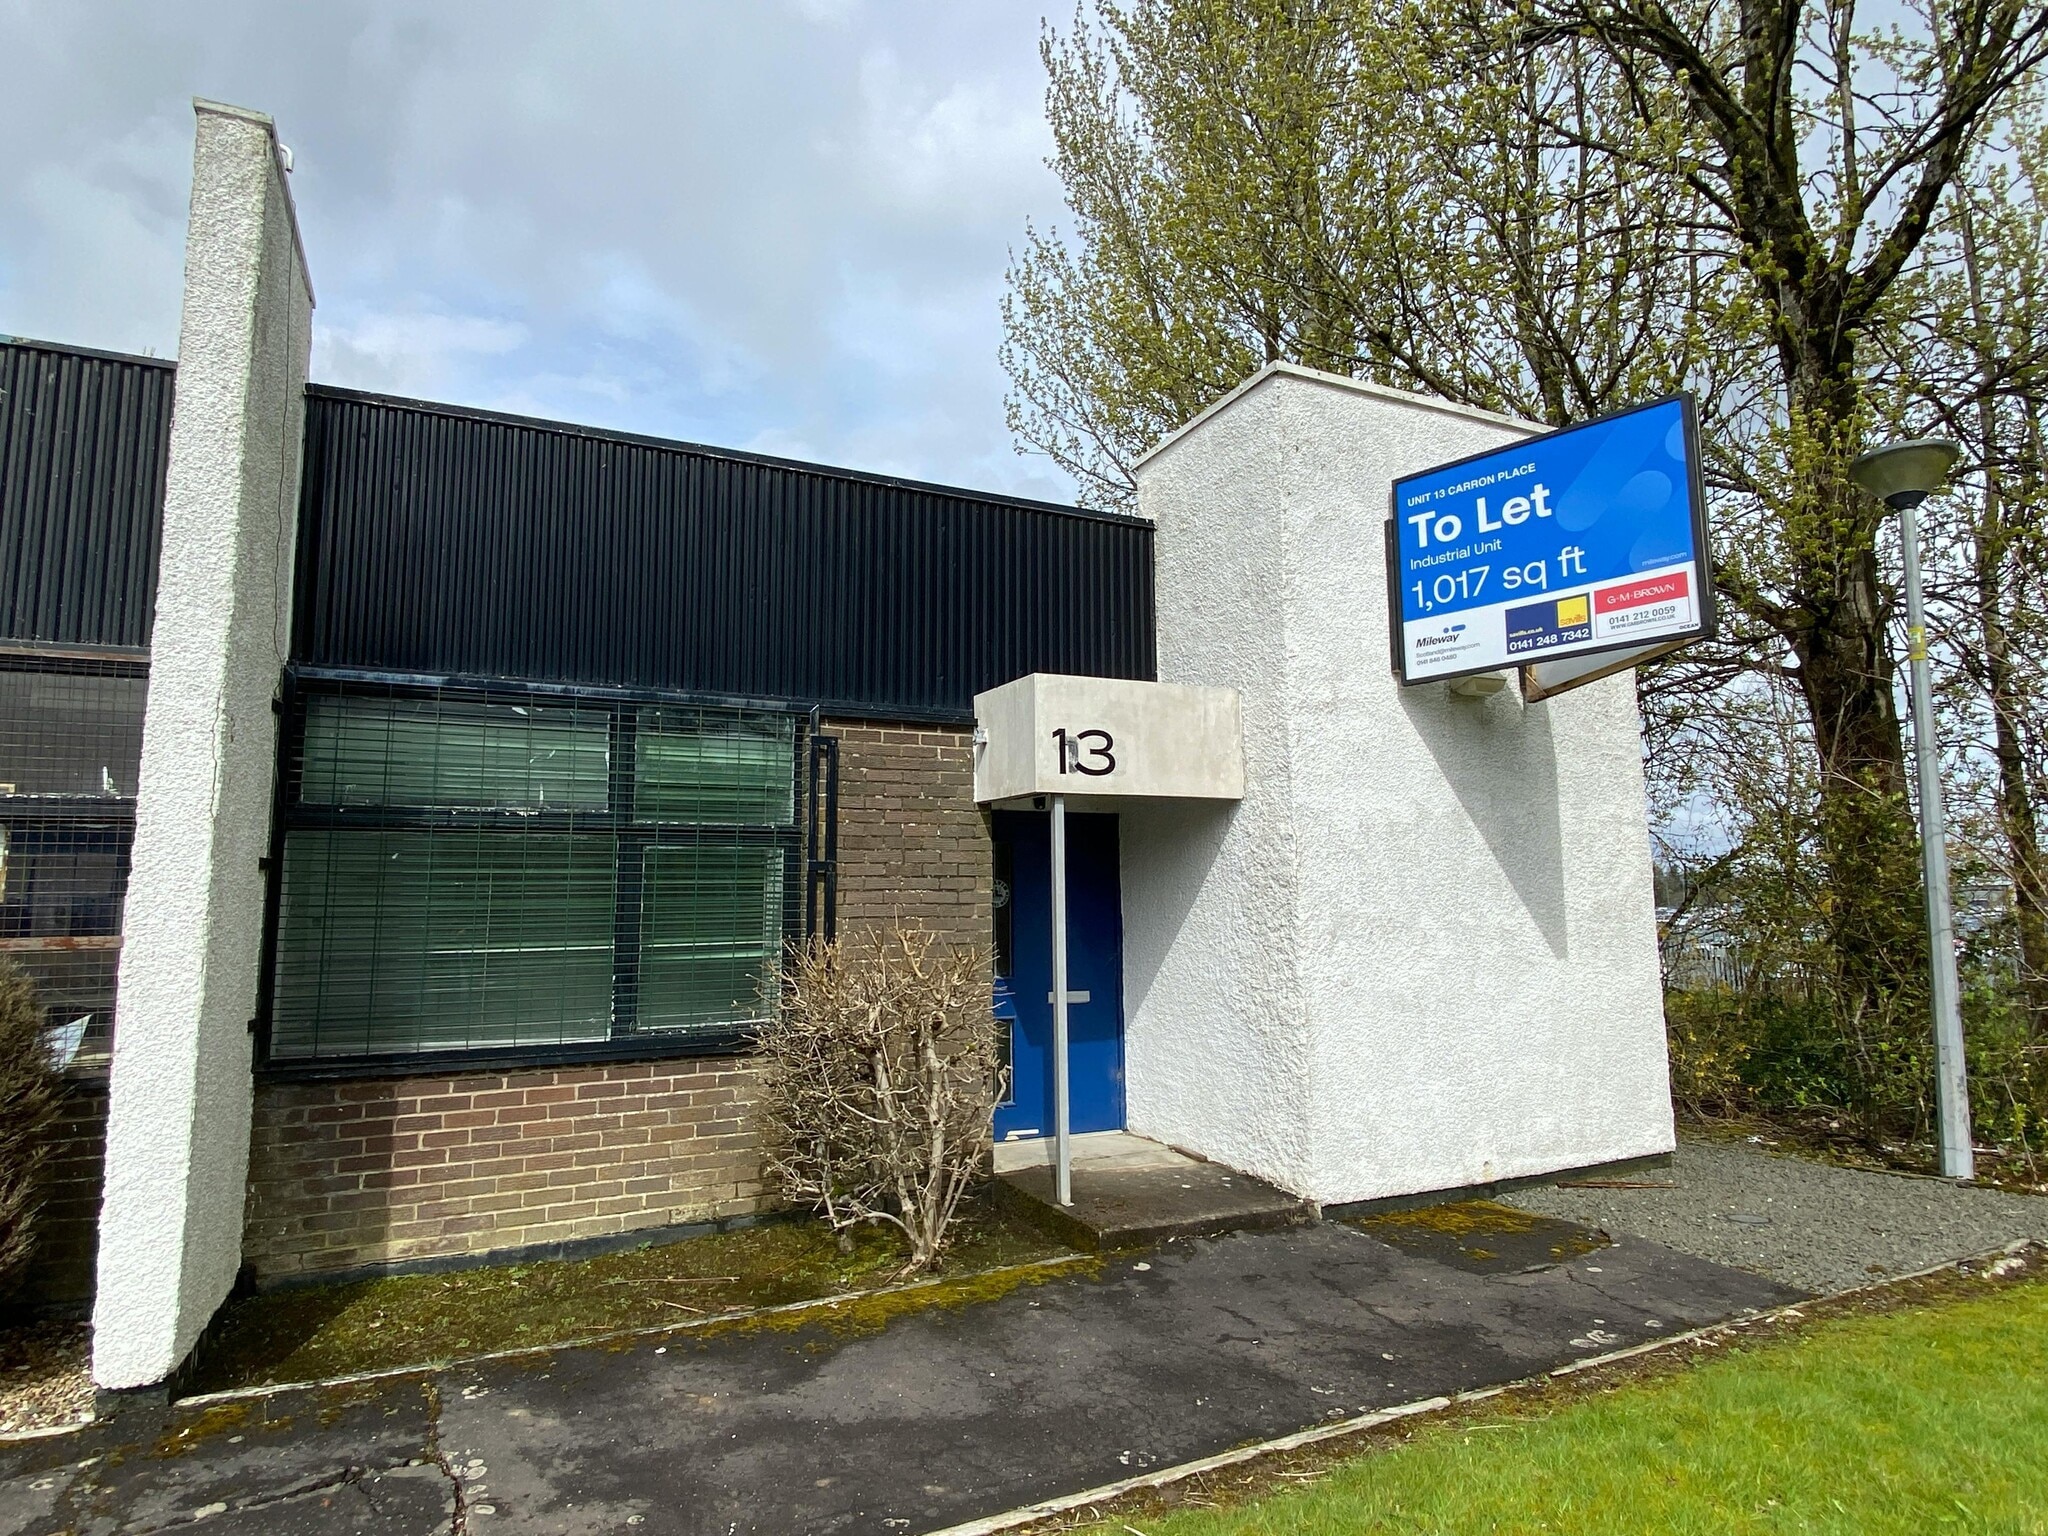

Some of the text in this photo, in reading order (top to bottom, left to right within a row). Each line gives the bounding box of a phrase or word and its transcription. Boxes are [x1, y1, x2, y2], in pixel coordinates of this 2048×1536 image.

[1407, 462, 1537, 507] UNIT 13 CARRON PLACE
[1407, 482, 1553, 549] To Let
[1410, 538, 1503, 571] Industrial Unit
[1411, 545, 1588, 612] 1,017 sq ft
[1559, 613, 1587, 626] savills
[1609, 605, 1676, 625] 0141 212 0059
[1415, 633, 1460, 648] Mileway
[1509, 628, 1590, 651] 0141 248 7342
[1051, 728, 1116, 776] 13
